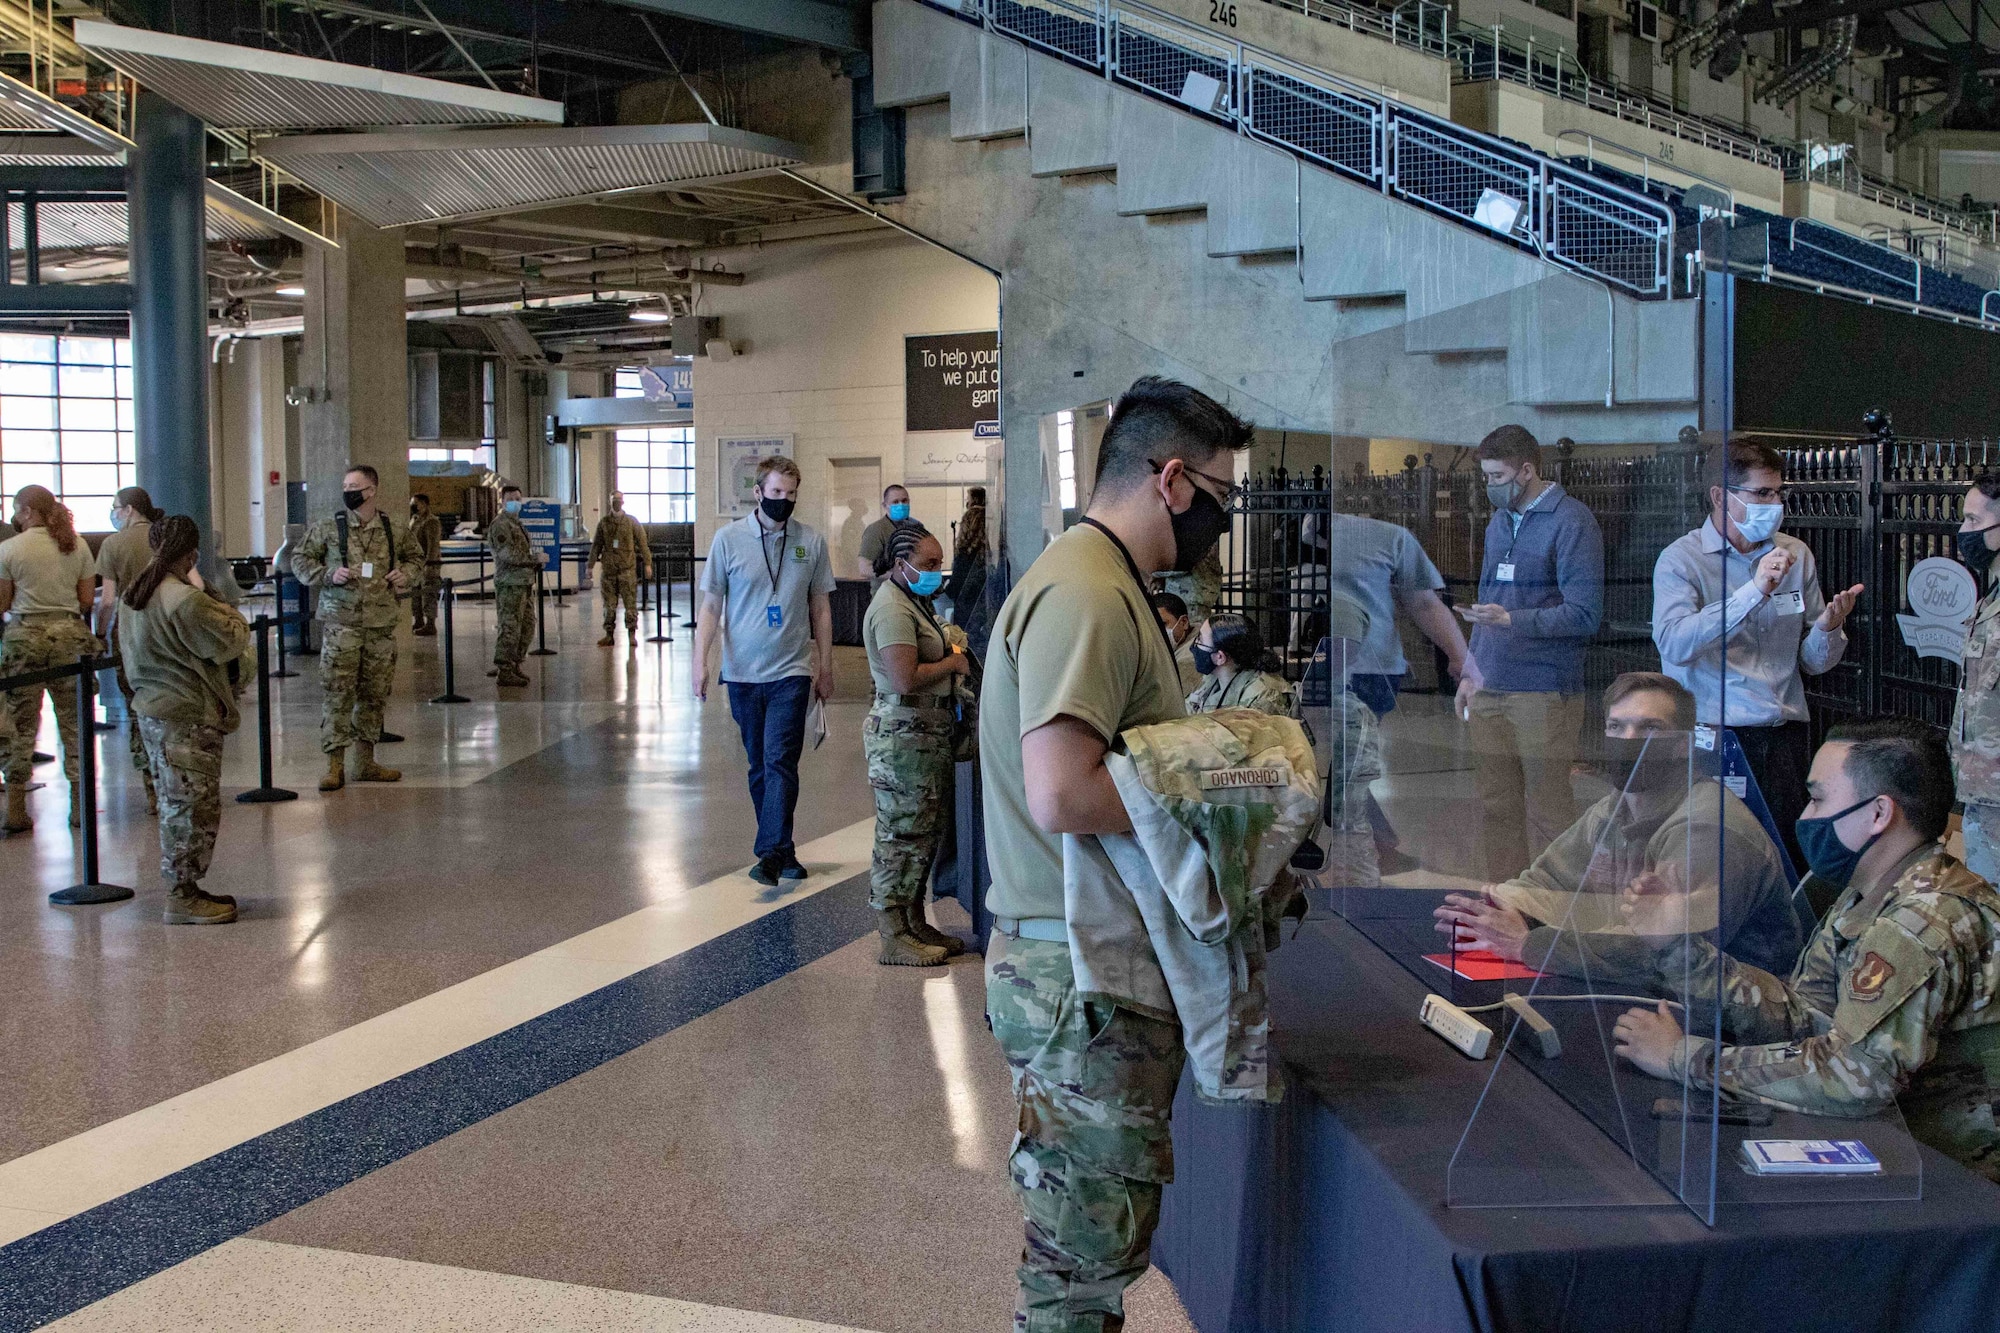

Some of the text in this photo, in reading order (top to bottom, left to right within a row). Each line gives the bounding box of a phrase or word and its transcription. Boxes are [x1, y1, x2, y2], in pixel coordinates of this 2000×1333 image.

[1209, 0, 1237, 28] 246
[1659, 141, 1674, 162] 245
[921, 348, 999, 369] To help your
[942, 371, 962, 386] we
[966, 366, 988, 388] put
[971, 388, 999, 408] gam
[977, 424, 999, 435] Come
[1922, 571, 1960, 608] Ford
[1920, 632, 1961, 648] FORD FIELD
[1211, 769, 1279, 787] CORONADO
